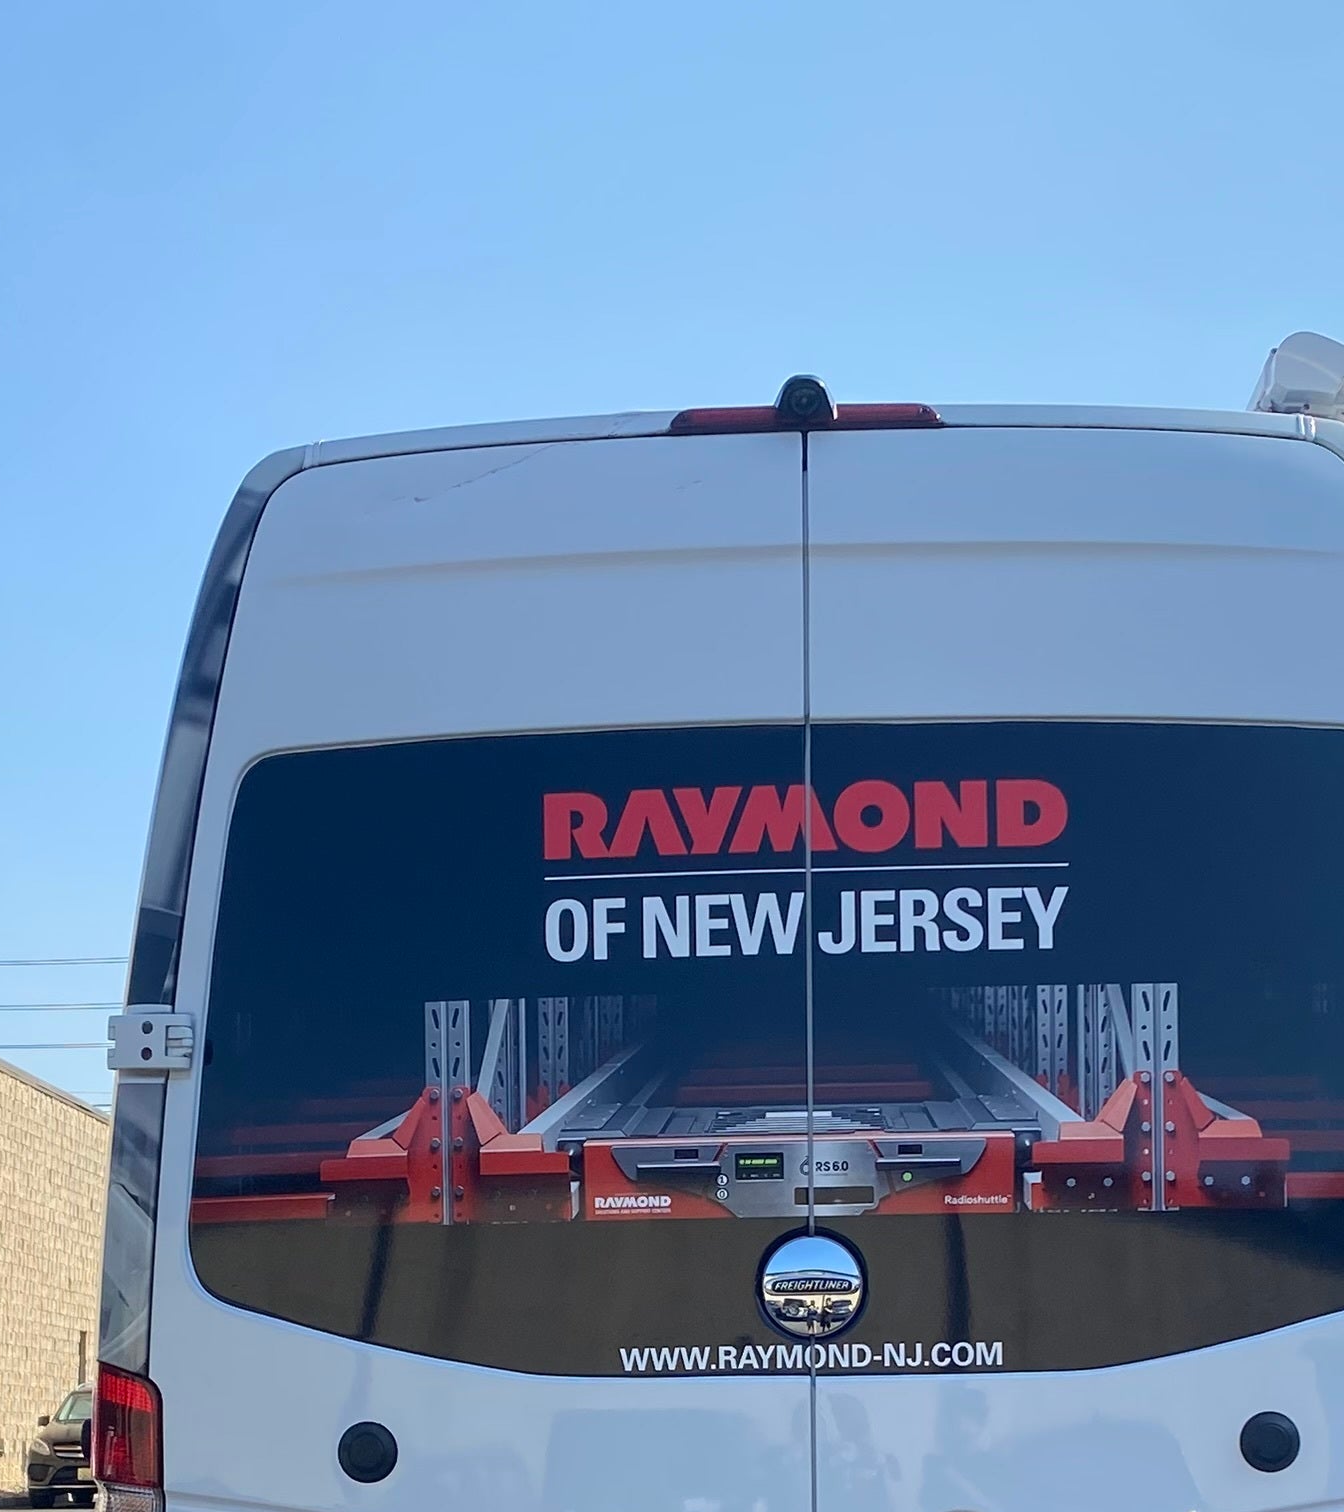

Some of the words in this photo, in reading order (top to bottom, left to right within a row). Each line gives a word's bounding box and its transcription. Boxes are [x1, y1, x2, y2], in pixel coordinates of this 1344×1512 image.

[543, 779, 1068, 860] RAYMOND
[544, 897, 626, 962] OF
[642, 891, 805, 959] NEW
[817, 886, 1069, 954] JERSEY
[815, 1161, 831, 1172] RS
[594, 1195, 672, 1209] RAYMOND
[944, 1194, 1008, 1205] Radioshuttle
[774, 1280, 850, 1291] FREIGHTLINER
[619, 1341, 1003, 1372] WWW.RAYMOND-NJ.COM
